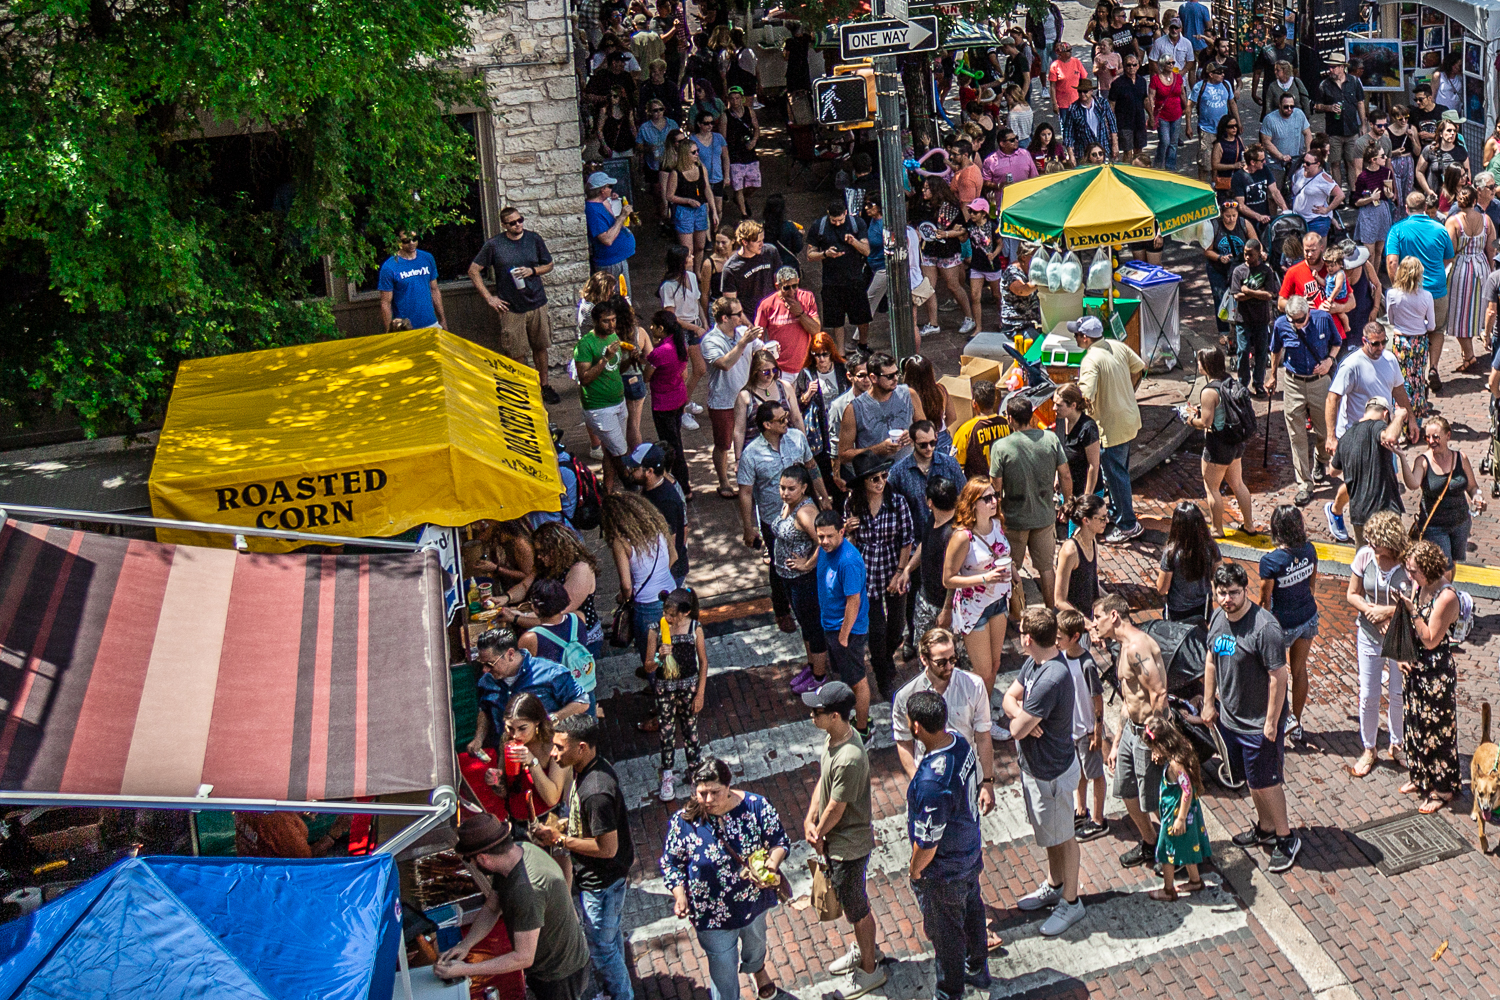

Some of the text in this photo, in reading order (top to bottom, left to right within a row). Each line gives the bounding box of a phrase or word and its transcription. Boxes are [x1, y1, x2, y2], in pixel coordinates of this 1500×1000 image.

[852, 29, 908, 48] ONE WAY
[1159, 204, 1218, 233] LEMONADE
[1069, 226, 1153, 248] LEMONADE
[400, 268, 422, 280] Hurley
[493, 373, 532, 411] CORN
[498, 404, 543, 464] ROASTED
[977, 425, 1010, 444] GWYNN
[216, 467, 388, 512] ROASTED
[256, 500, 354, 533] CORN
[930, 755, 947, 776] 4
